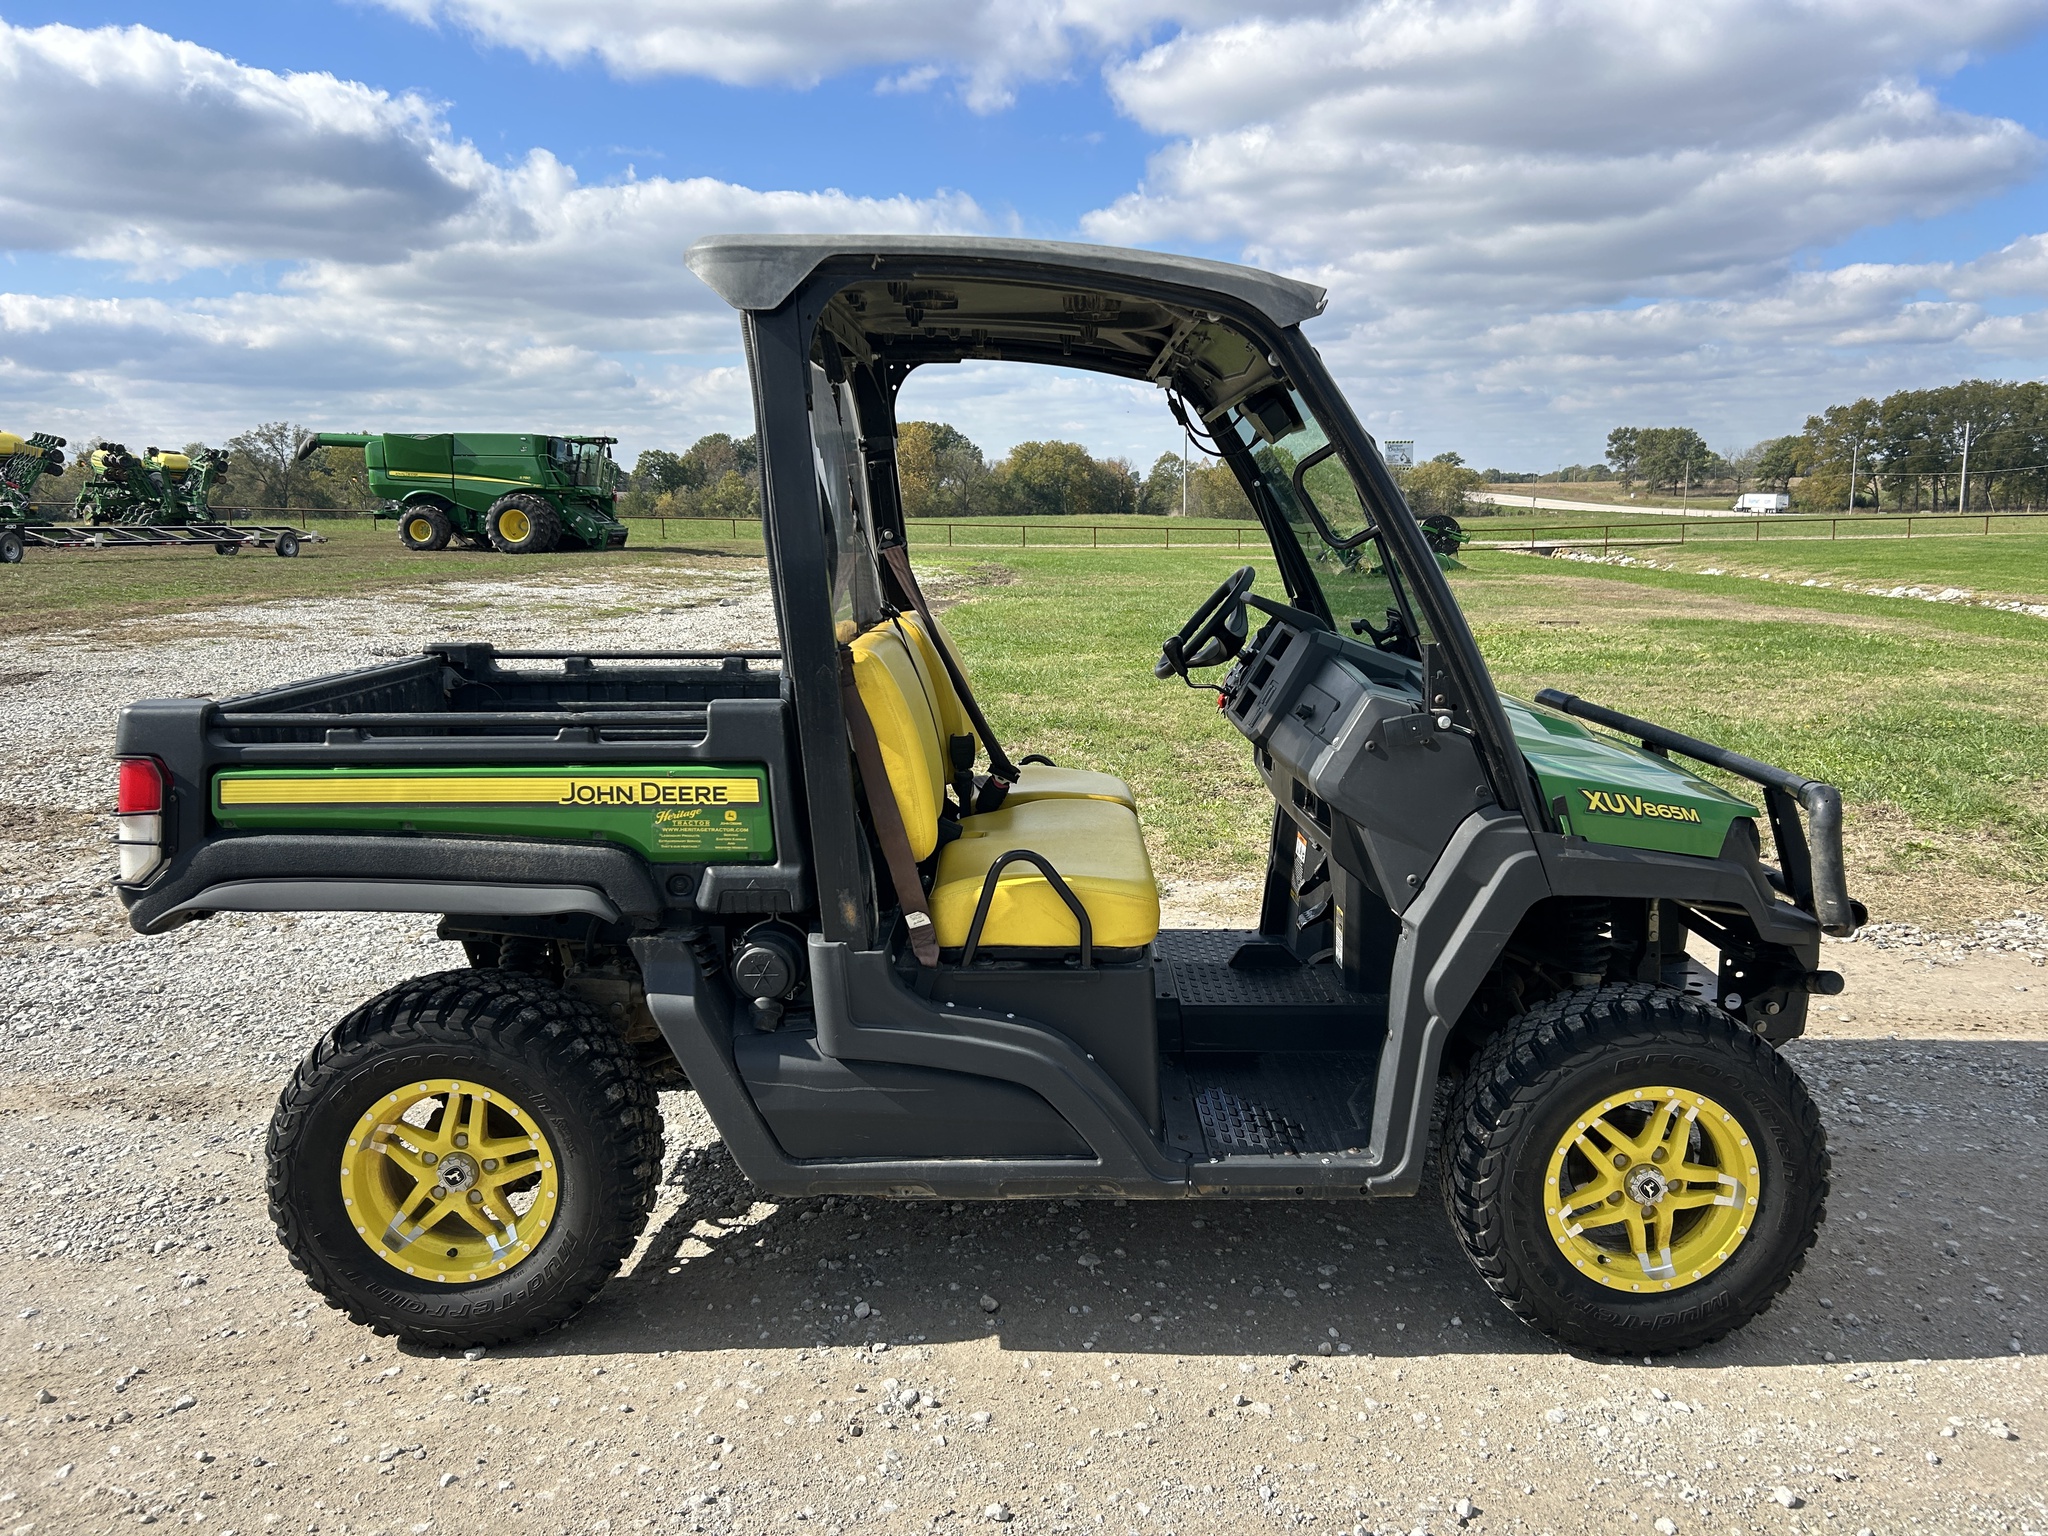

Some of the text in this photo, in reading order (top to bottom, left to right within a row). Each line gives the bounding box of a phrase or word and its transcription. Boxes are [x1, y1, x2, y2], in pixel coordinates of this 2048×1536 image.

[561, 781, 728, 803] JOHN DEERE
[655, 808, 702, 824] Heritage
[1580, 789, 1701, 824] XUV865M
[329, 1052, 553, 1114] BFGoodrich
[1614, 1052, 1799, 1184] BFGoodrich
[365, 1229, 580, 1320] Mud-Terrain
[1519, 1238, 1731, 1331] Mud-Terrain
